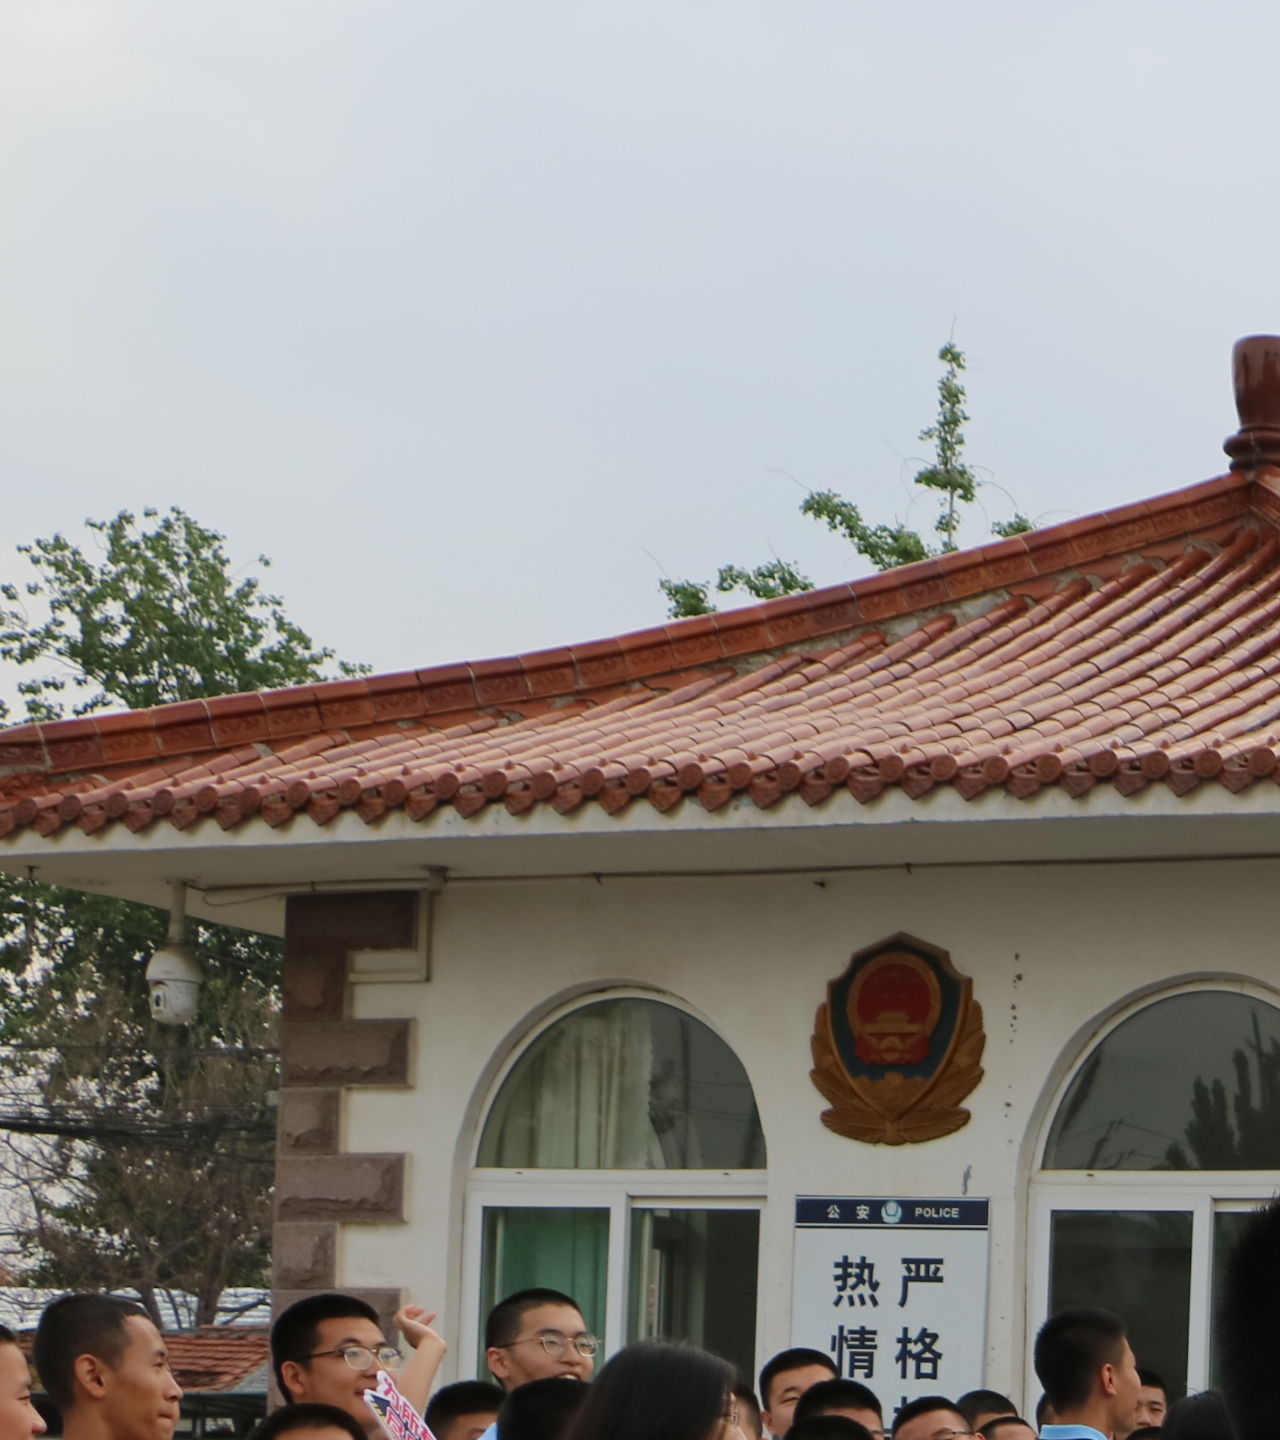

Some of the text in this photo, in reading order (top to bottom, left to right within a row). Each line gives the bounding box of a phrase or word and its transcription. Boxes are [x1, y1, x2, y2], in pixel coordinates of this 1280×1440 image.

[826, 1204, 960, 1220] 公安 POLICE
[831, 1255, 880, 1379] 热情
[894, 1257, 944, 1413] 严格
